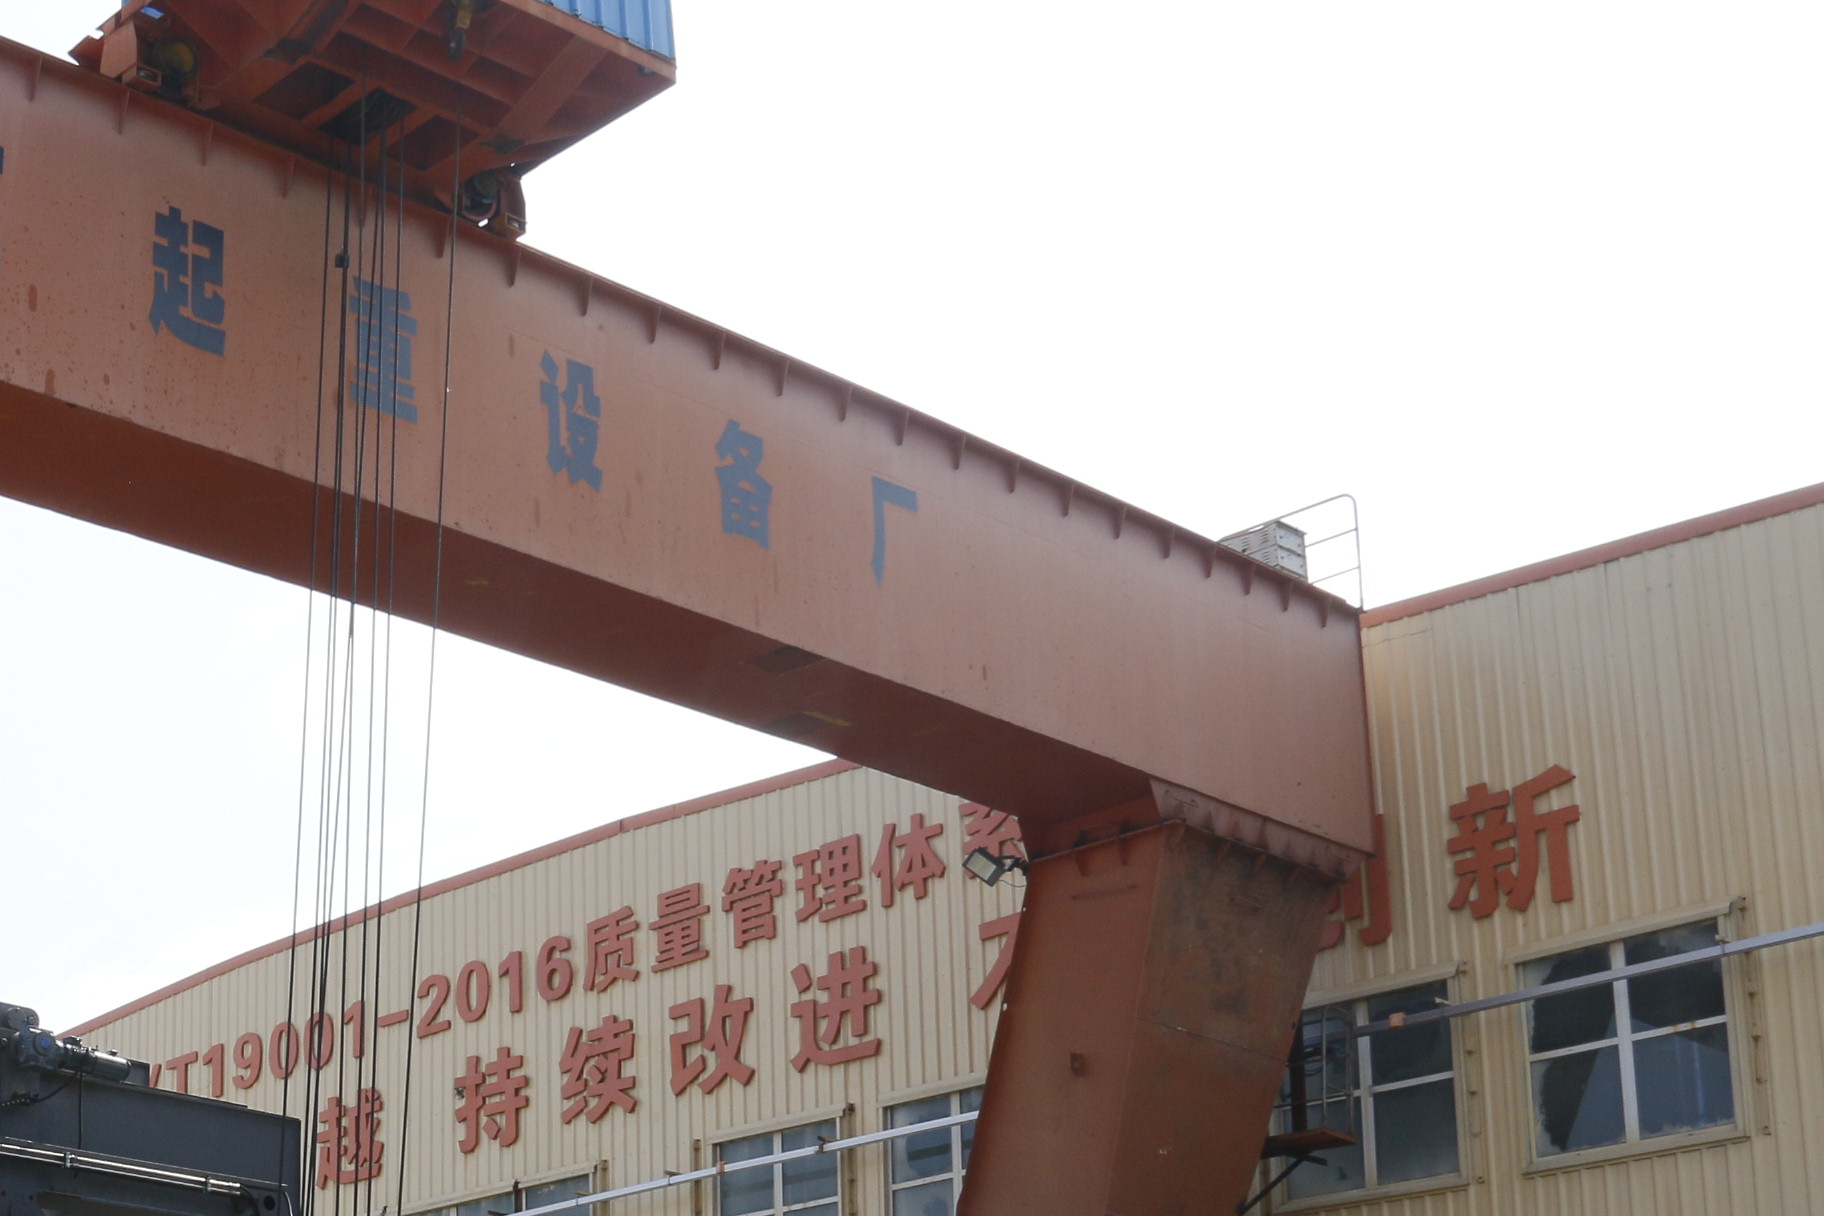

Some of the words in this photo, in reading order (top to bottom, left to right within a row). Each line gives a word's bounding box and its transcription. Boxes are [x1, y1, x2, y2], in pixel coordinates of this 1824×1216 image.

[316, 1086, 384, 1190] 越
[454, 945, 882, 1154] 持续改进
